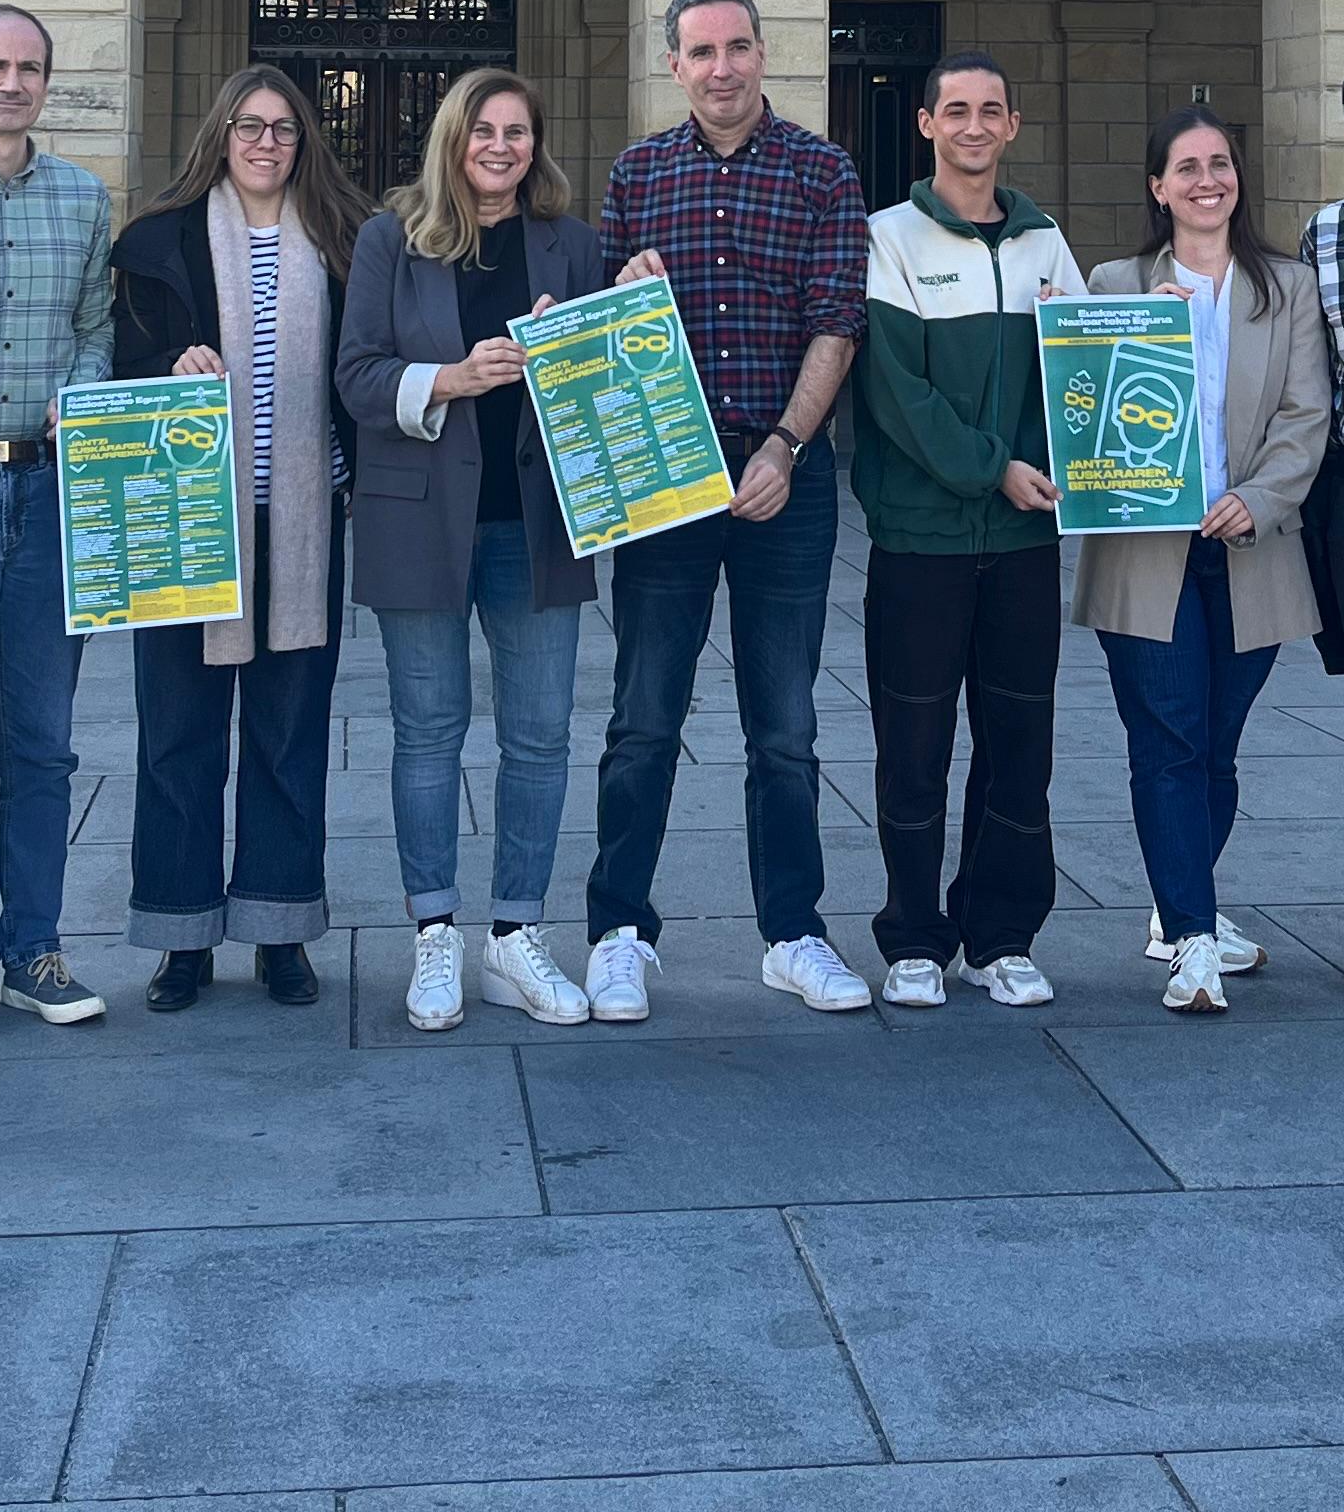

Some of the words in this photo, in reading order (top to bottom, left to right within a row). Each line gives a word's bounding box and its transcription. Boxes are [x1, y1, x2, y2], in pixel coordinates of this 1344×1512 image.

[1077, 309, 1151, 318] Euskararen
[1057, 317, 1131, 327] Nazioarteko
[1132, 316, 1174, 326] Eguna
[1065, 459, 1116, 470] JANTZI
[1066, 468, 1169, 481] EUSKARAREN
[1068, 477, 1186, 491] BETAURREKOAK
